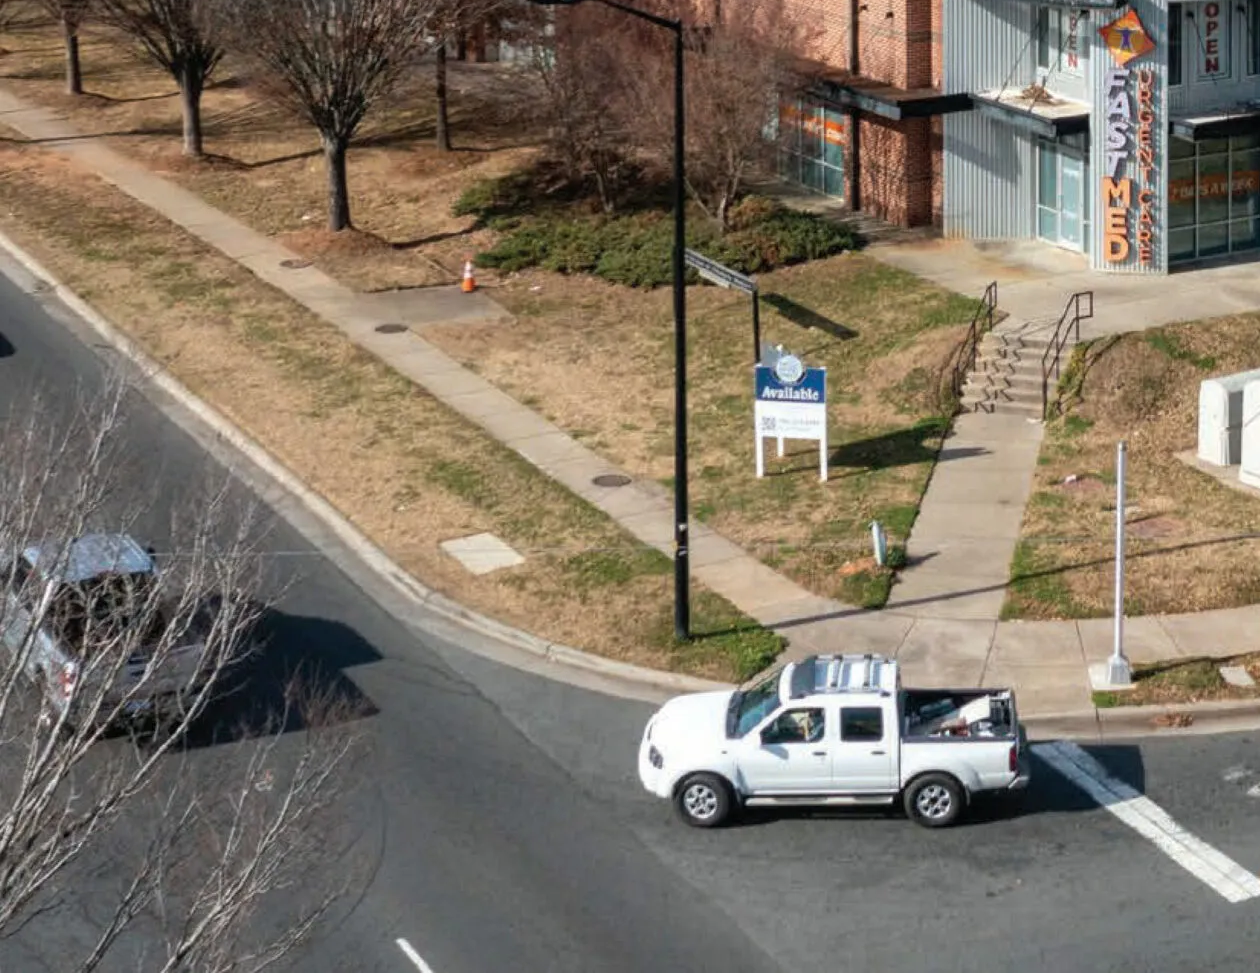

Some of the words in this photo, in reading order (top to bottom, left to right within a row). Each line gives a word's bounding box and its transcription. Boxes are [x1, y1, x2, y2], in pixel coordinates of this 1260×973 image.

[1204, 2, 1219, 73] OPEN
[1137, 69, 1154, 182] URGENT
[1137, 188, 1153, 265] CARE
[762, 386, 819, 401] Available
